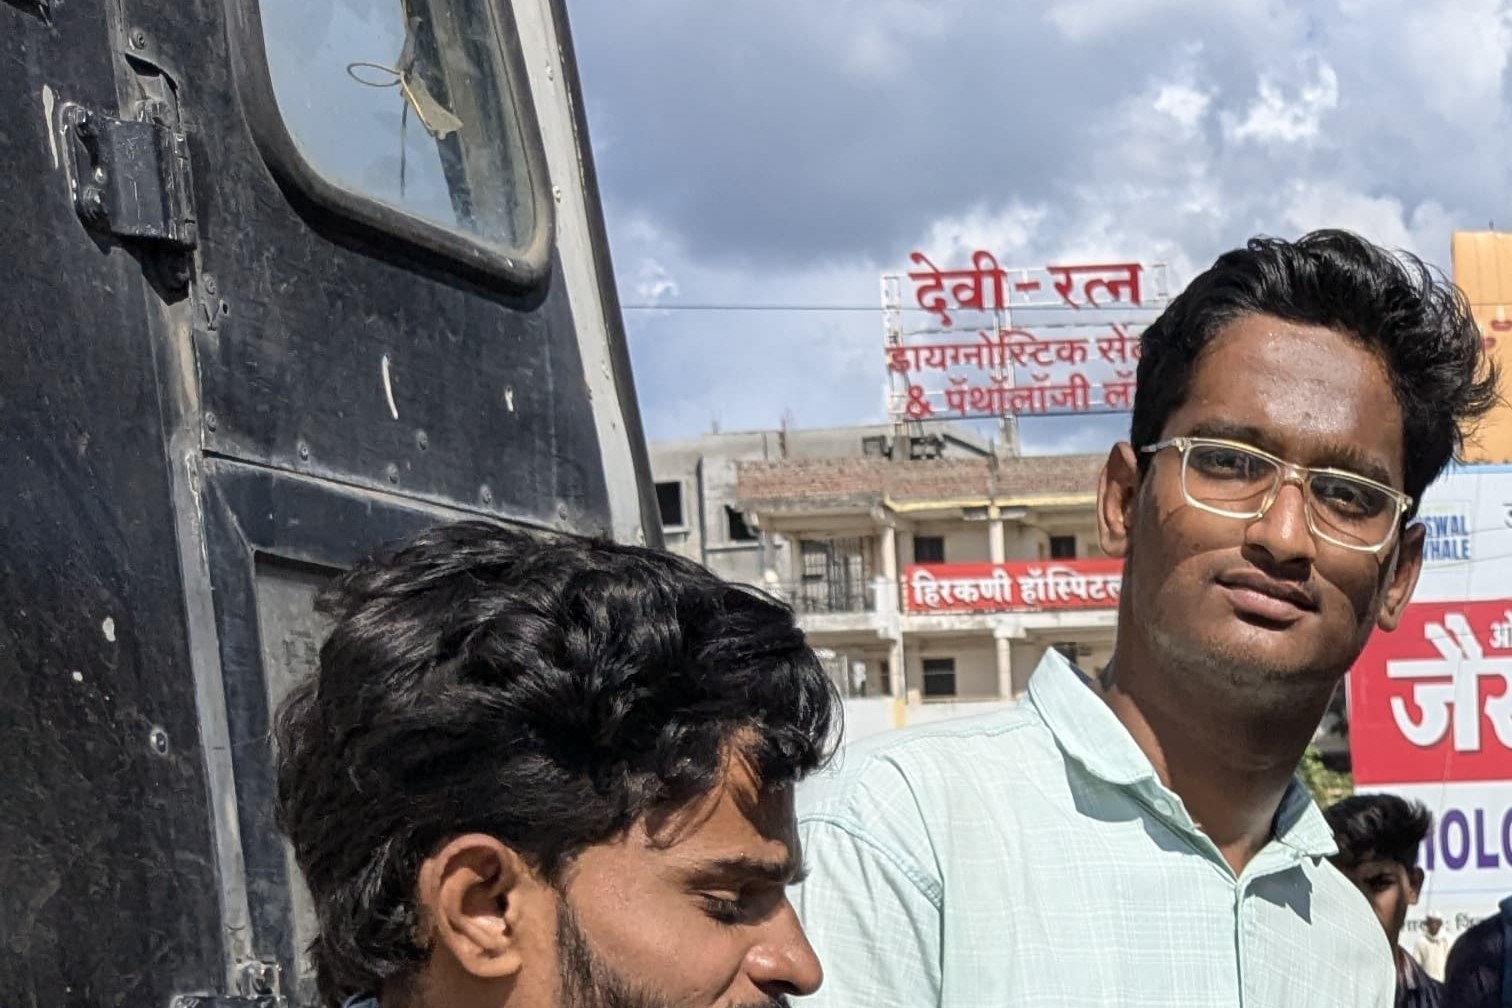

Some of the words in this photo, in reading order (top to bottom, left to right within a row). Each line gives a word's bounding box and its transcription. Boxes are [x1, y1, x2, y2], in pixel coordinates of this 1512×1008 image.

[886, 328, 1089, 373] डायग्नोस्टिक
[906, 385, 935, 419] &
[911, 568, 1012, 608] हिरकणी
